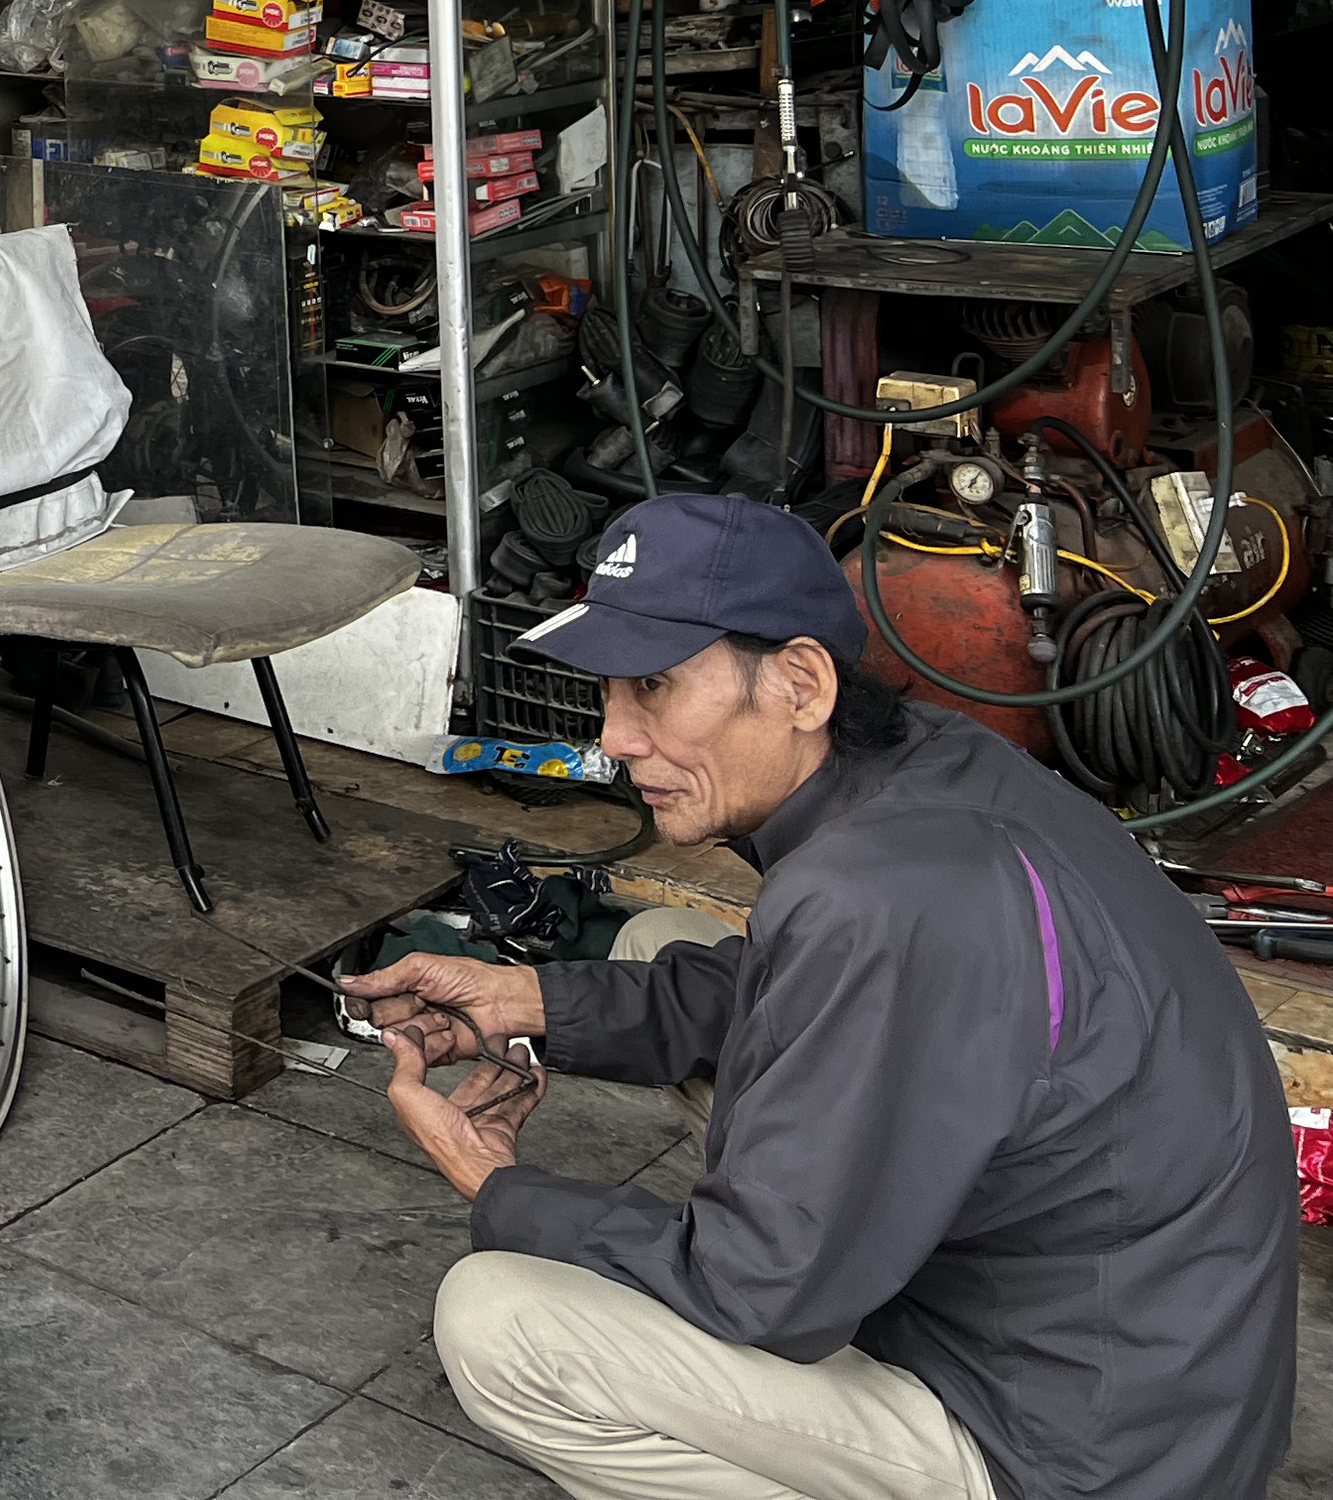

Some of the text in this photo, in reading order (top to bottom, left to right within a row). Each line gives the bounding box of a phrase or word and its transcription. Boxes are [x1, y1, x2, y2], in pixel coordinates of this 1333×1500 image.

[966, 74, 1162, 136] laVie
[1012, 140, 1071, 157] KHOÁNG
[1075, 141, 1117, 156] THIÊN
[1121, 140, 1155, 156] NHIÊ
